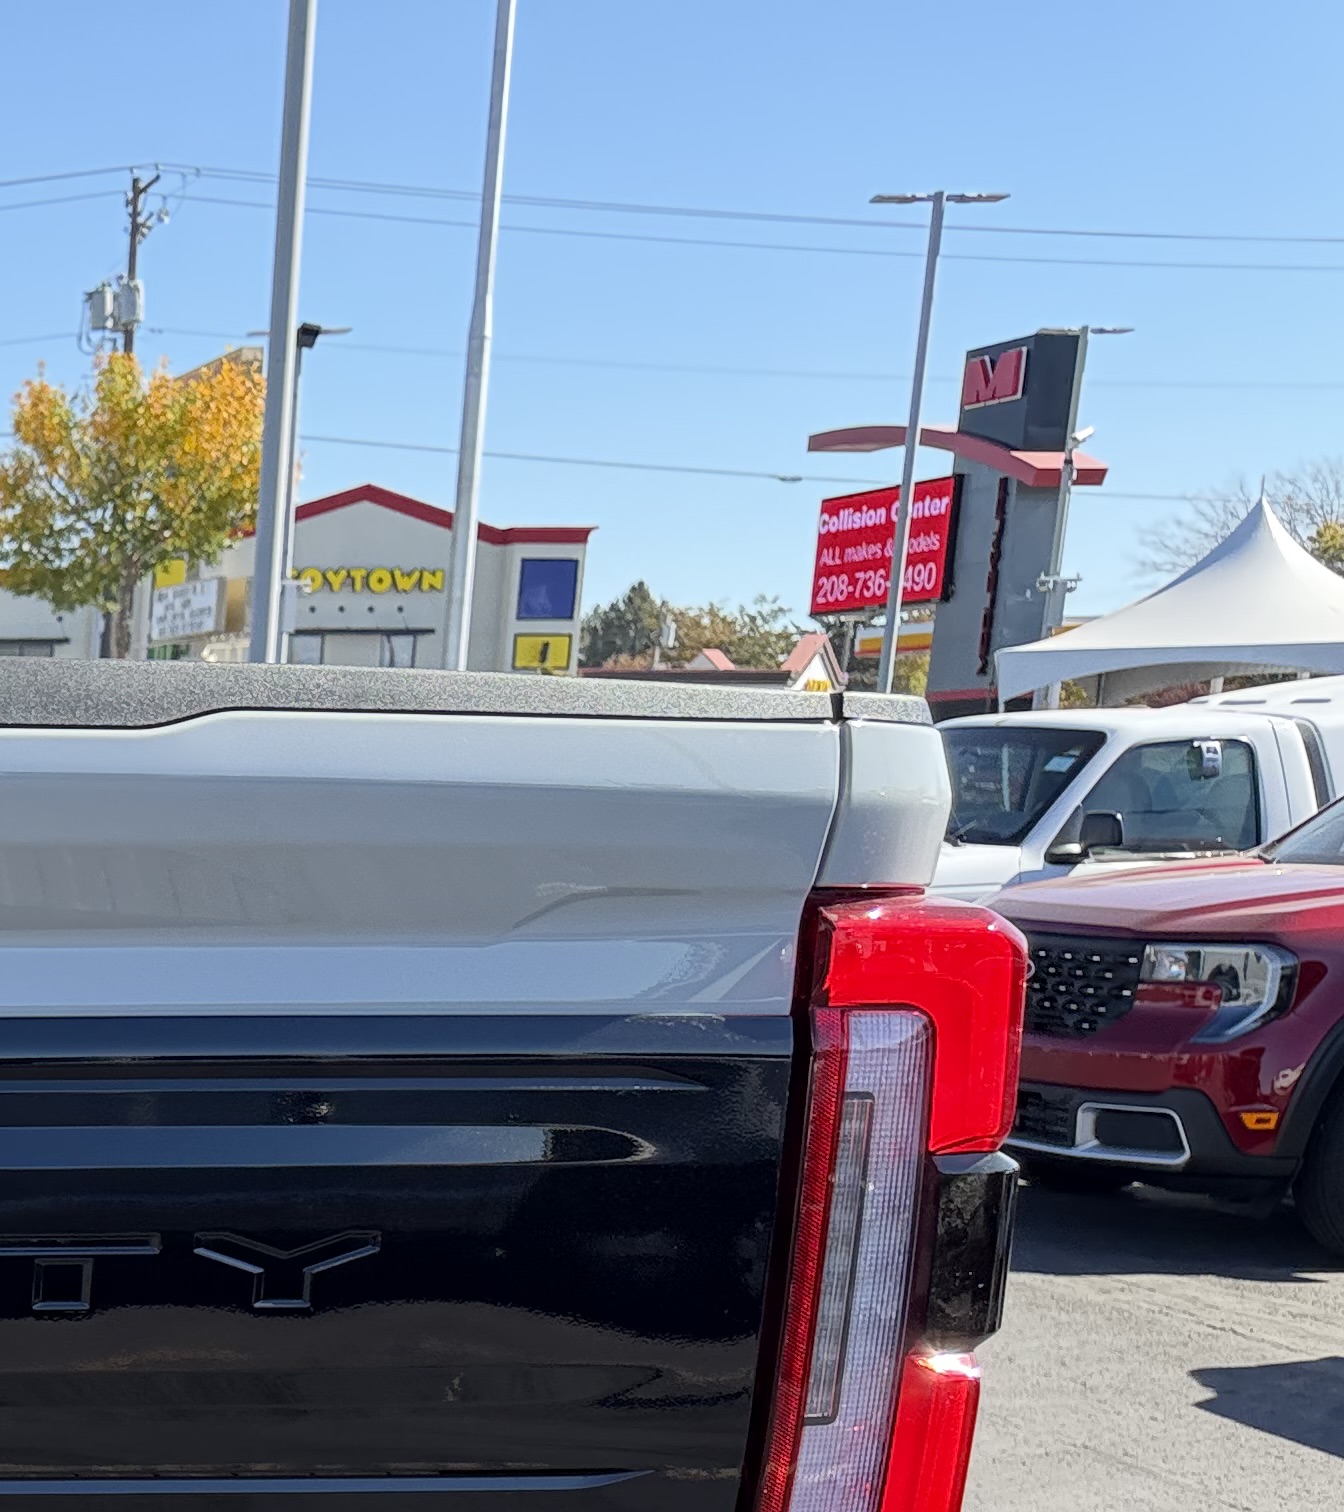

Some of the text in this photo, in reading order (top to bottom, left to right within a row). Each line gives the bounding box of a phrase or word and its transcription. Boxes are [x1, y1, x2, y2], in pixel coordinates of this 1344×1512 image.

[819, 495, 950, 535] Collision Cnter
[819, 546, 842, 566] ALL
[844, 541, 883, 563] makes
[905, 530, 940, 554] odels
[290, 567, 445, 595] OYTOWN
[816, 561, 937, 604] 208-736-490
